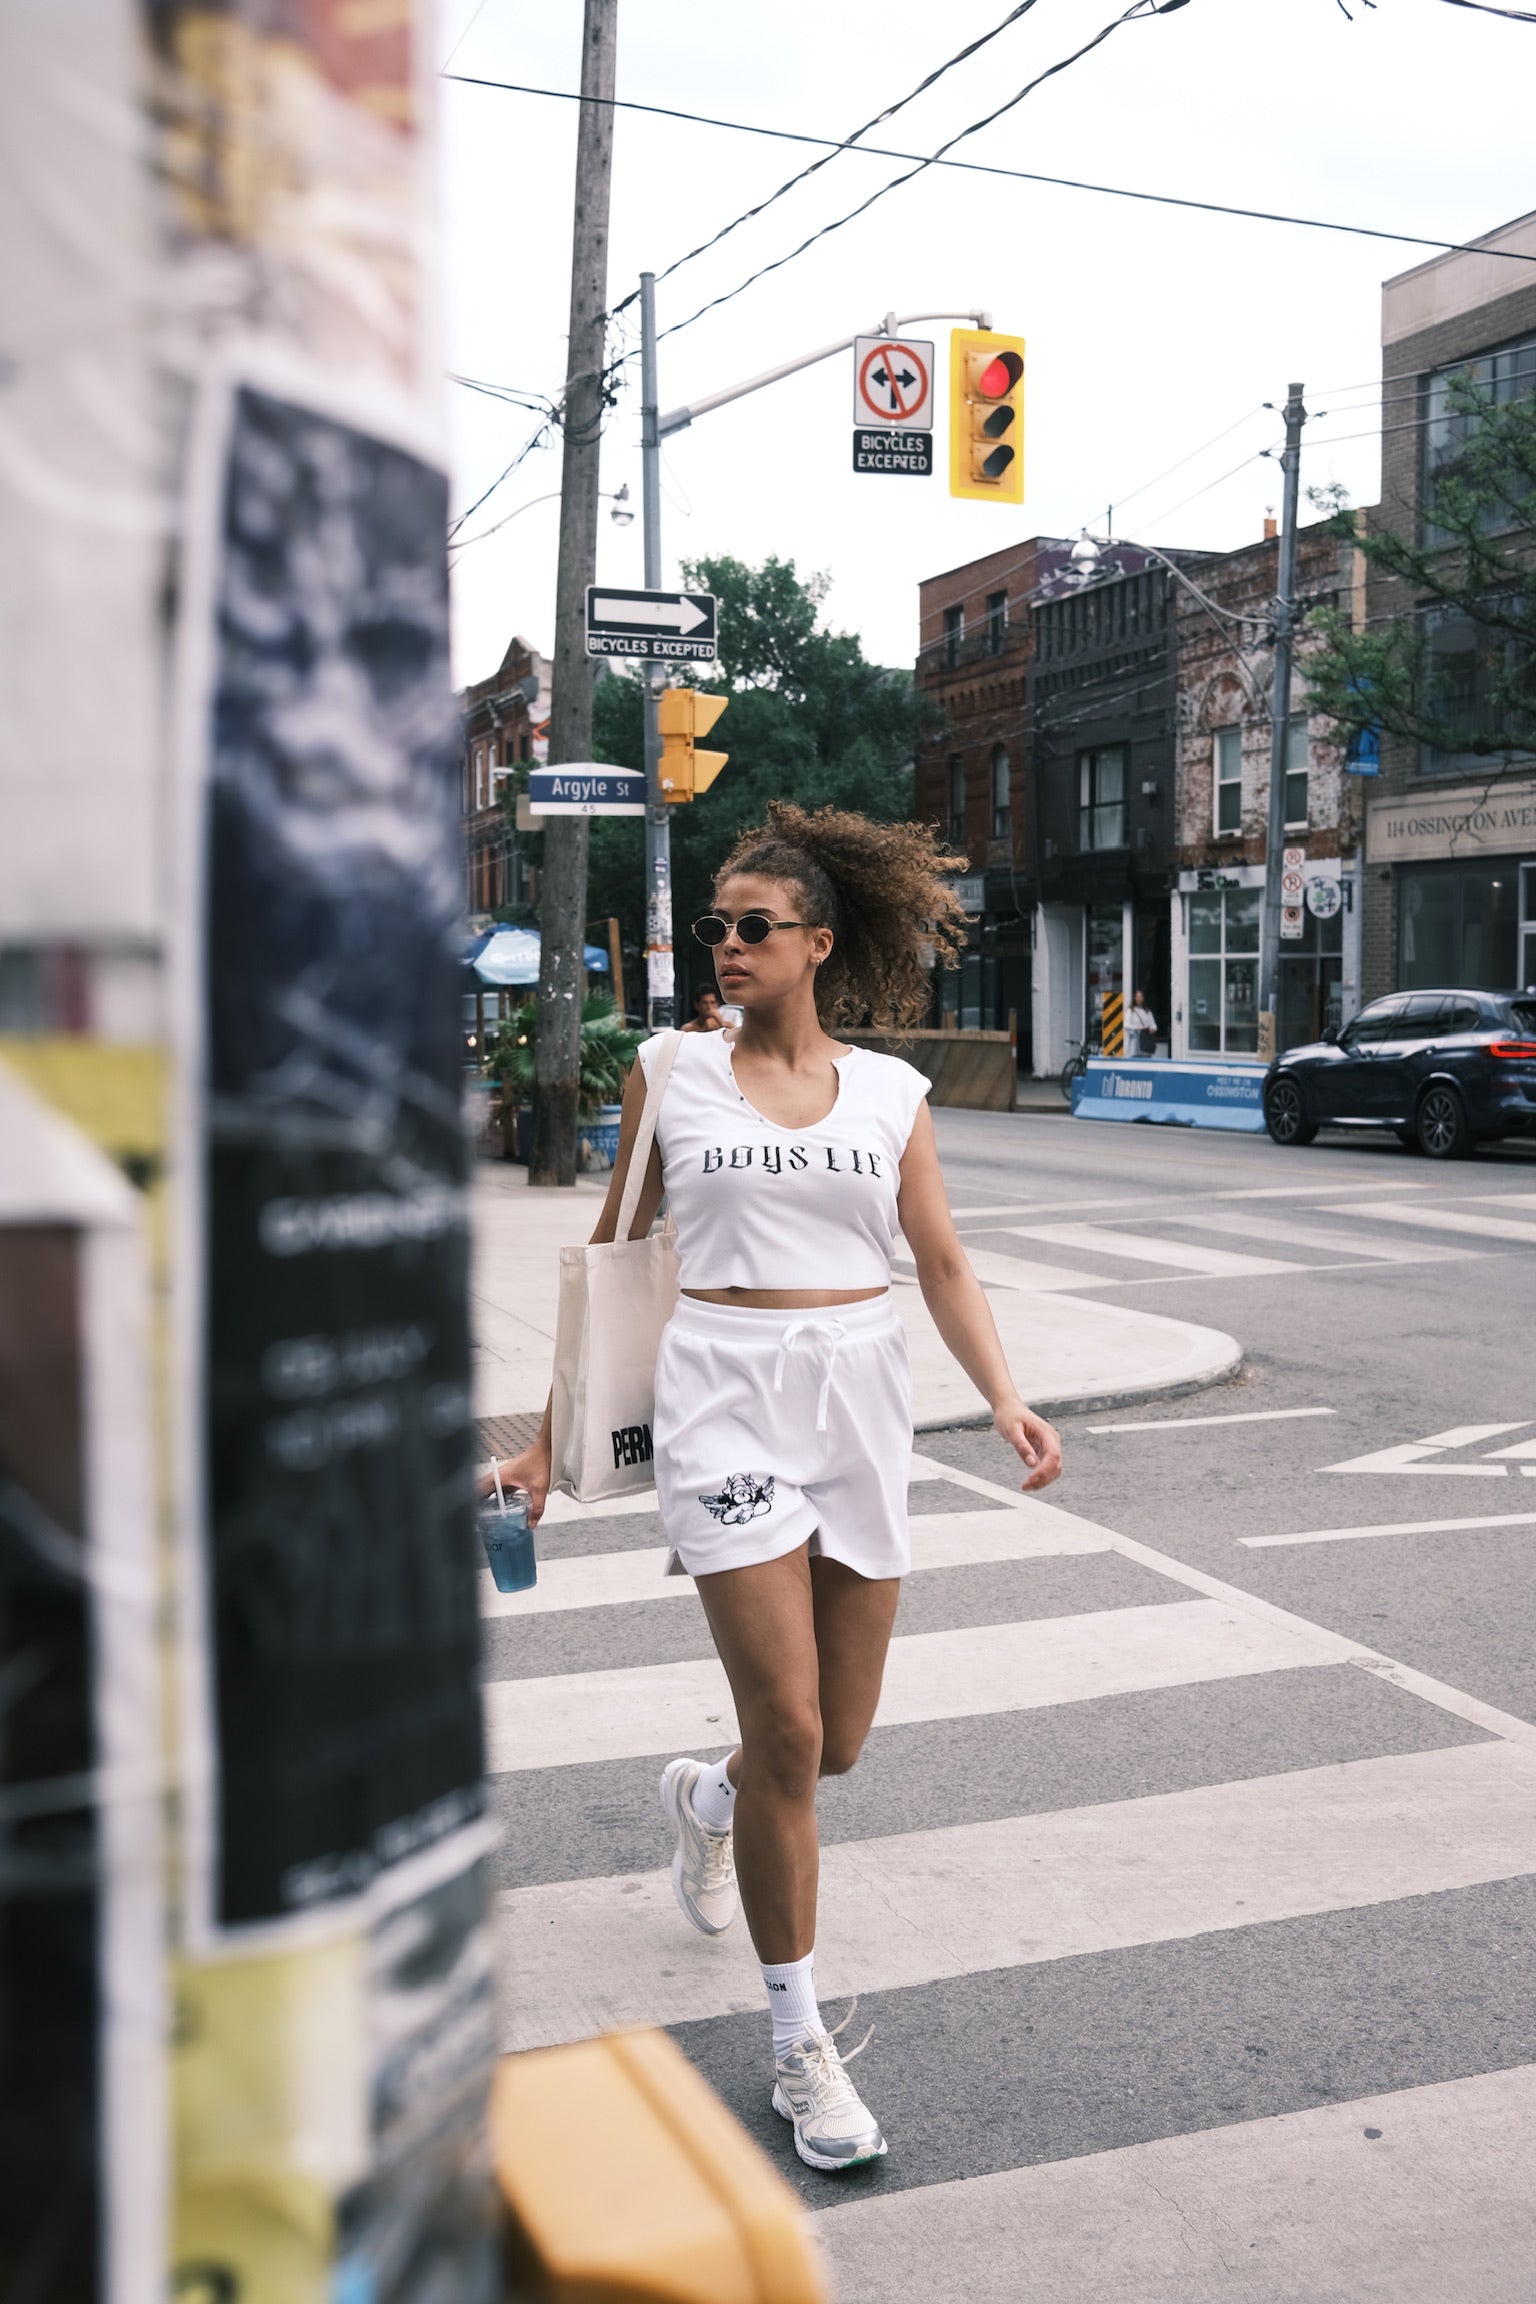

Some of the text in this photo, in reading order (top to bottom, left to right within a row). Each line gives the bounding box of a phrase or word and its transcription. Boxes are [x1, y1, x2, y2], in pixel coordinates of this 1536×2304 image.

[861, 434, 925, 452] BICYCLES
[857, 453, 928, 470] EXCEPTED
[588, 637, 715, 658] BICYCLES EXCEPTED
[552, 778, 629, 800] Argyle St
[580, 805, 596, 814] 45
[1387, 808, 1536, 838] 114 OSSINGTON AVE
[1115, 1075, 1153, 1099] TORONTO
[1206, 1085, 1259, 1099] OSSINGTON
[702, 1145, 809, 1175] BOYS
